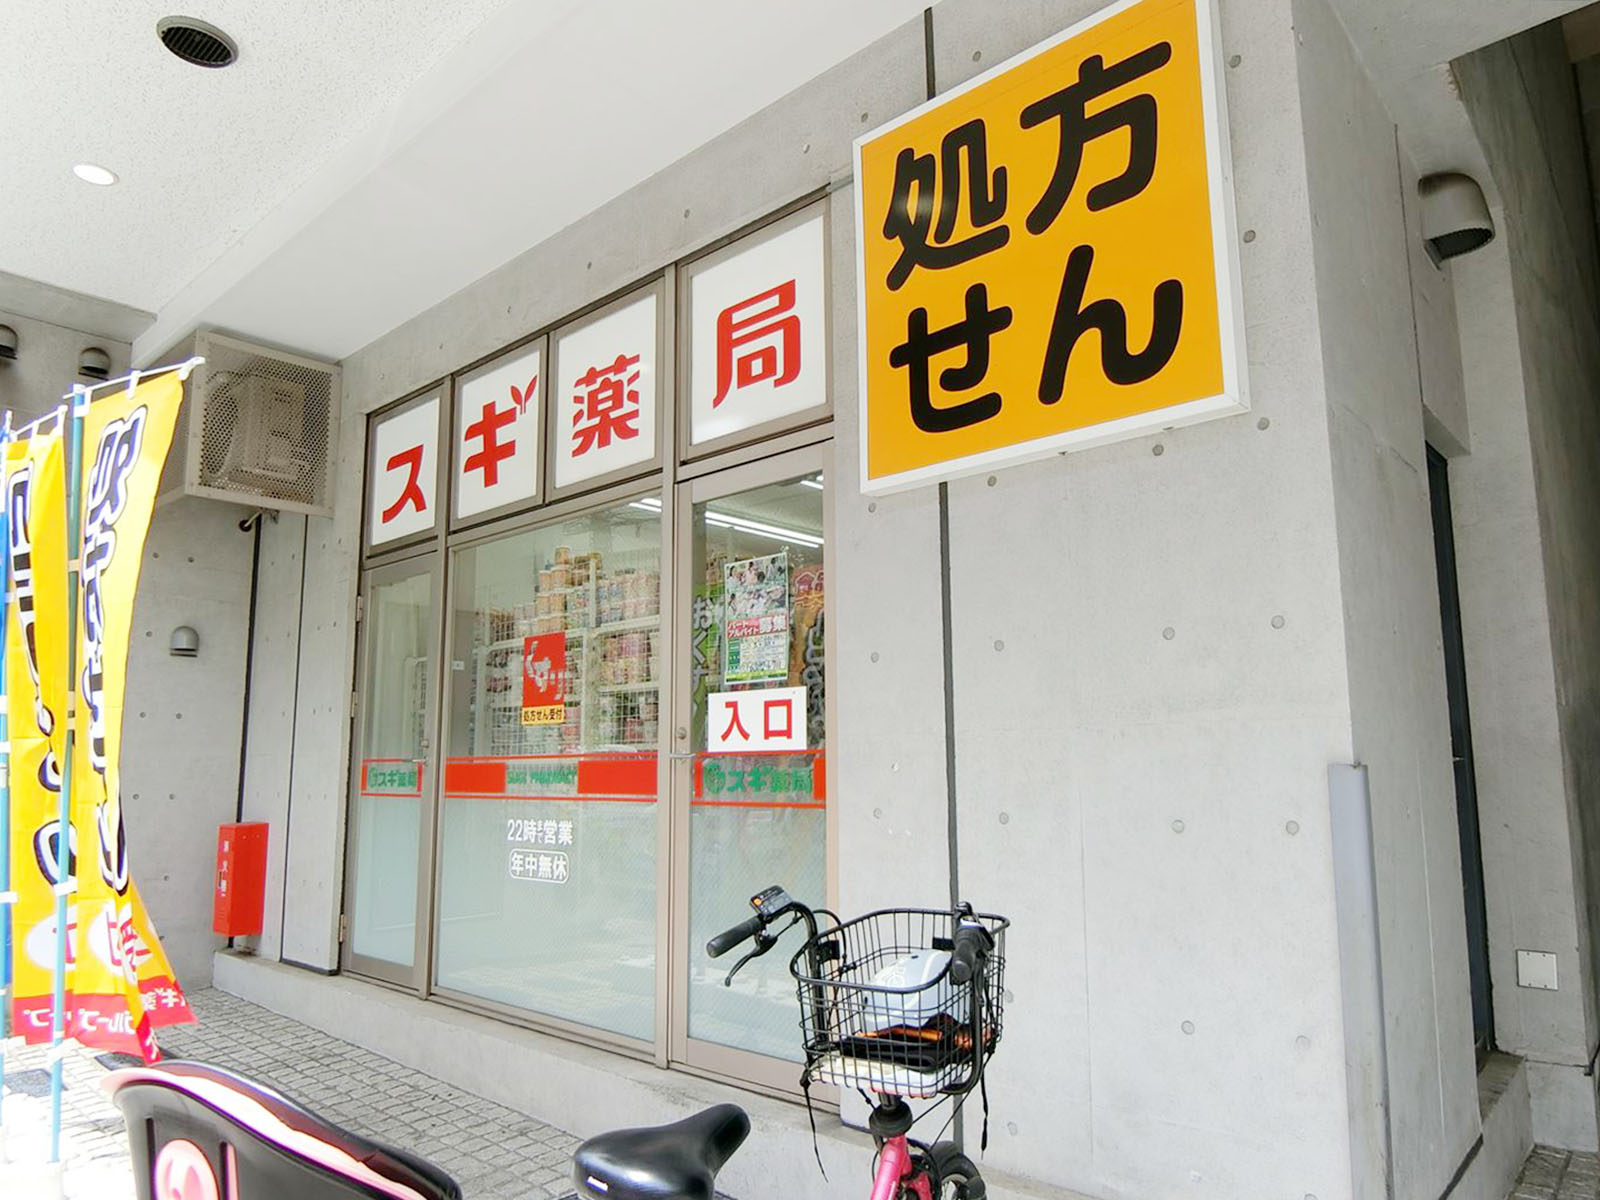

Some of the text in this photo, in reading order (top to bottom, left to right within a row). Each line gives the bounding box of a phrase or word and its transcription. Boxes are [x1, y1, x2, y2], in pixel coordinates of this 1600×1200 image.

[883, 41, 1172, 291] 処方
[889, 244, 1184, 434] せん
[382, 279, 801, 524] スギ薬局
[523, 708, 563, 722] 処方せん受付
[720, 699, 792, 742] 入口
[511, 853, 567, 880] 年中無休
